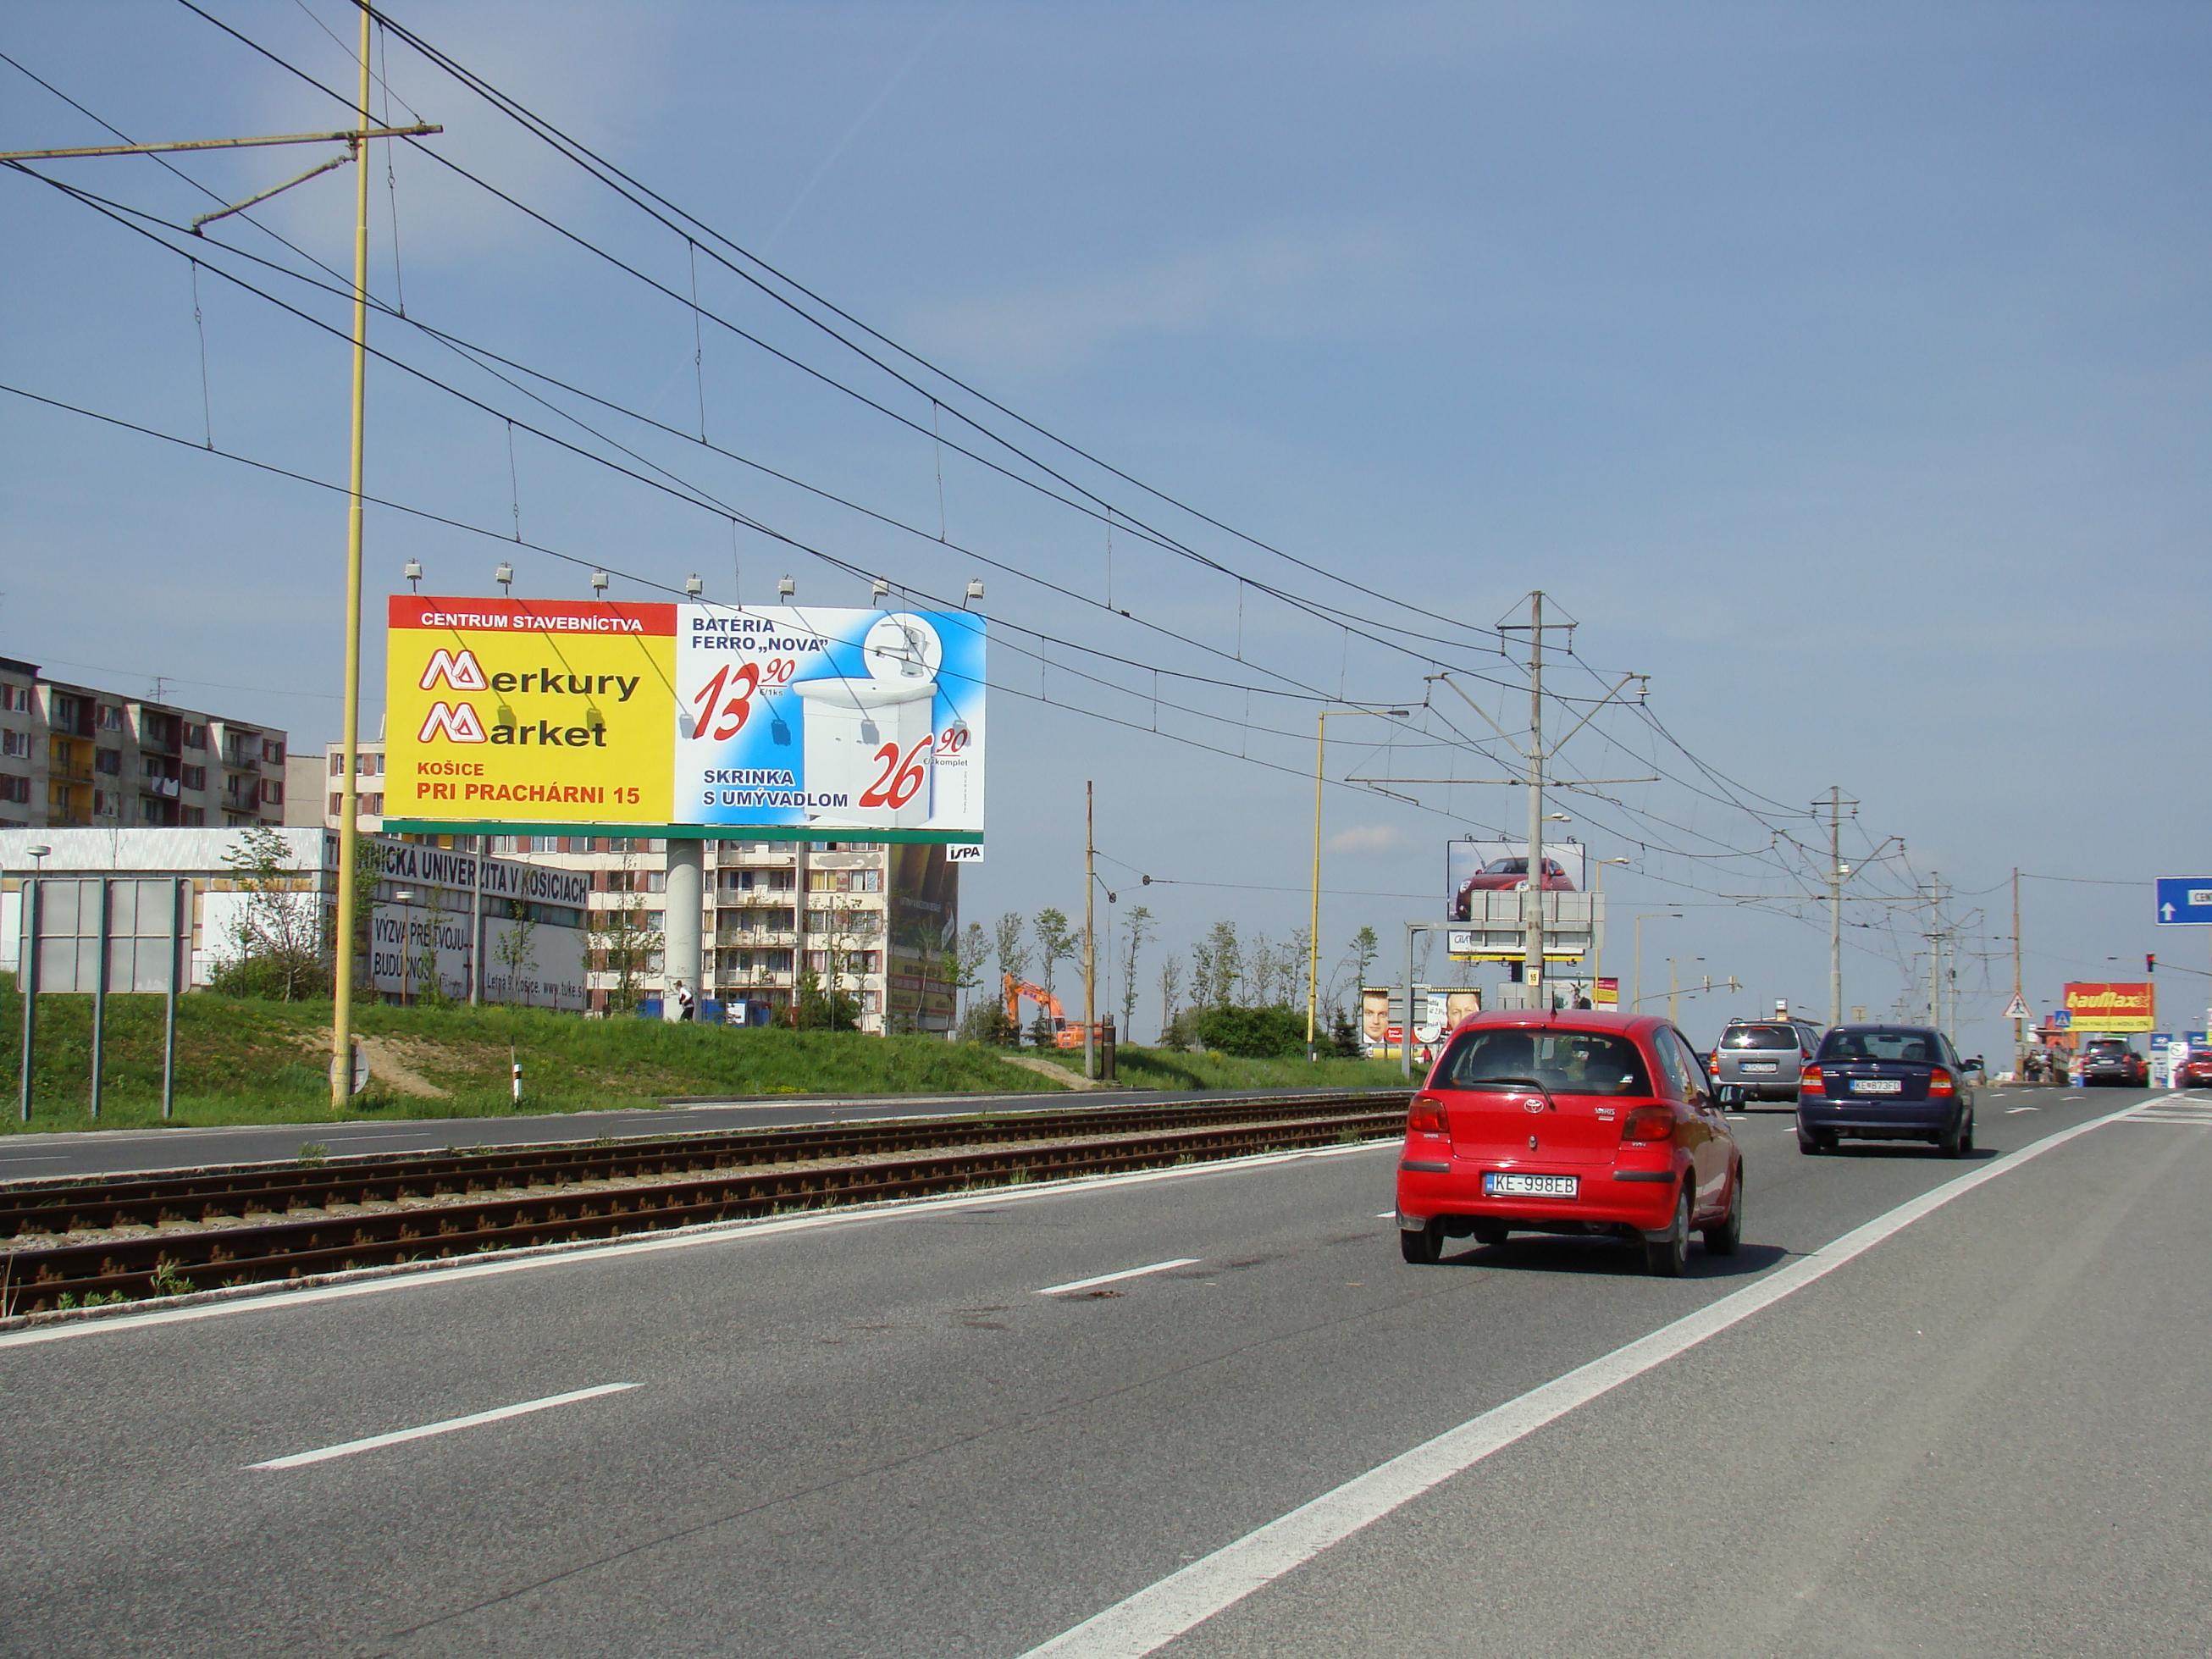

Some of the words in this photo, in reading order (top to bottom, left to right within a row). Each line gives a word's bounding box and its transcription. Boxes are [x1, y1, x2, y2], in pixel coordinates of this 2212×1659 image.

[421, 612, 508, 628] CENTRUM
[512, 614, 644, 632] STAVEBNÍCTVA
[693, 617, 775, 633] BATÉRIA
[693, 636, 755, 650] FERRO
[419, 649, 641, 702] Merkury
[418, 701, 608, 747] Market
[417, 760, 485, 777] KOŠICE
[704, 770, 794, 785] SKRINKA
[417, 782, 456, 800] PRI
[465, 782, 605, 804] PRACHÁRNI
[613, 788, 640, 804] 15
[703, 792, 715, 805] S
[722, 788, 848, 807] UMÝVADLOM
[511, 866, 519, 893] V
[410, 922, 430, 948] PRE
